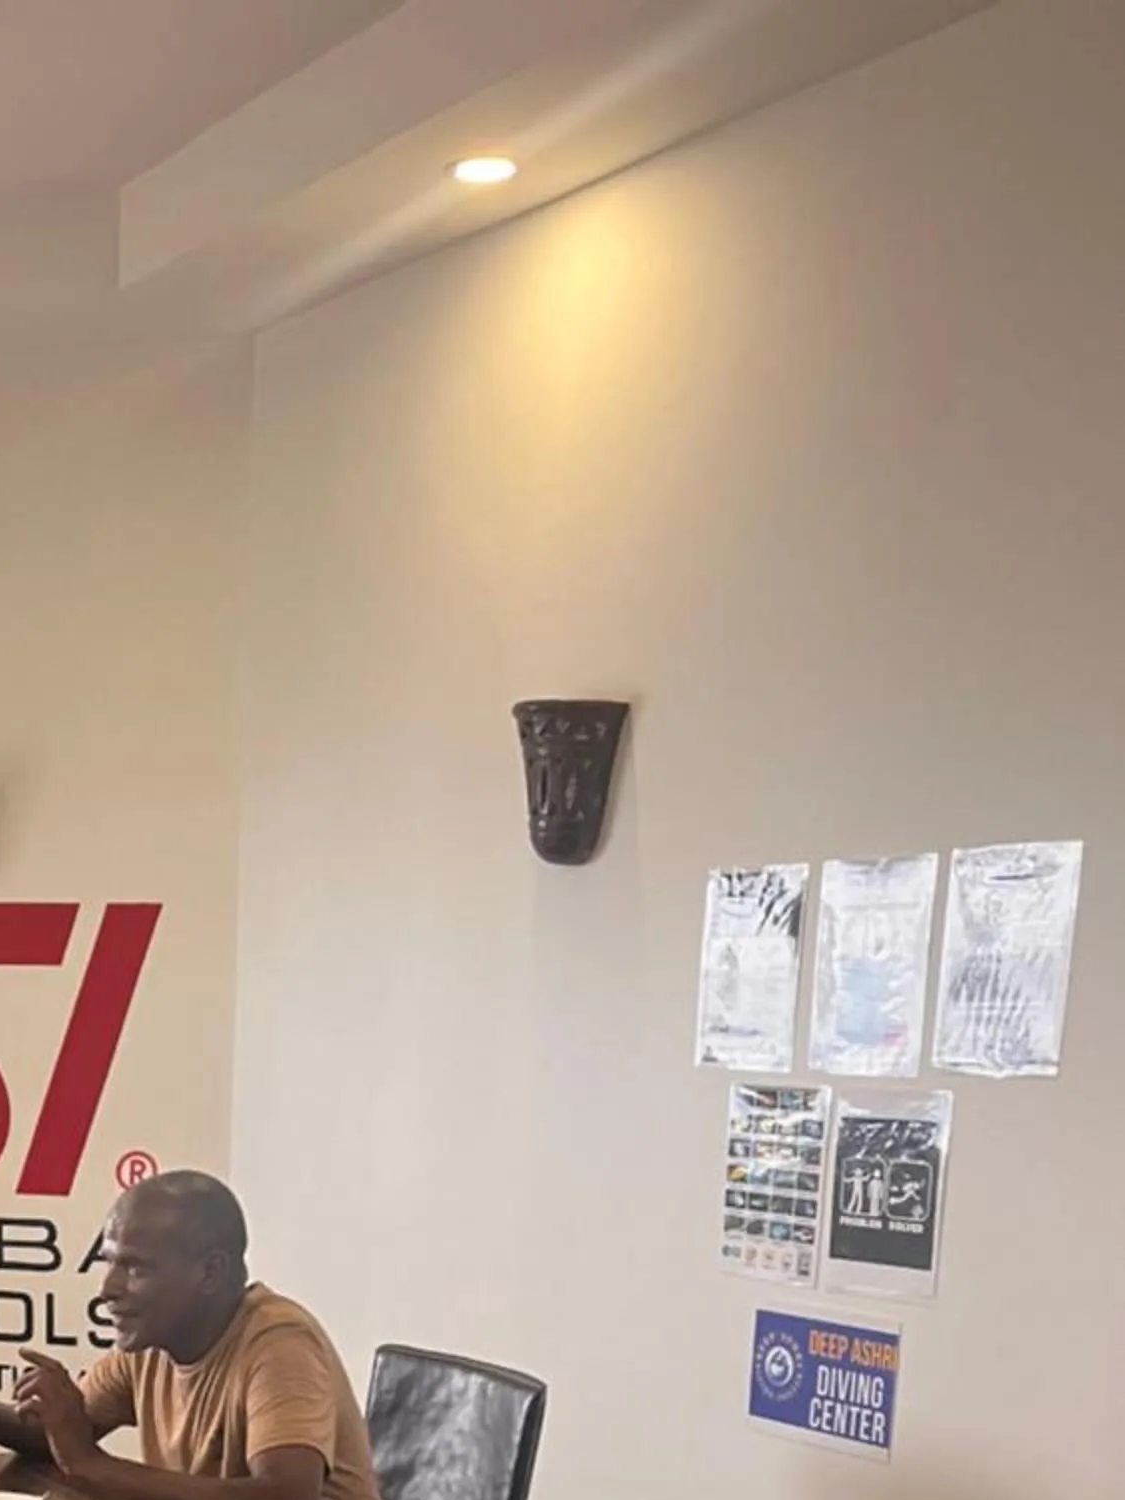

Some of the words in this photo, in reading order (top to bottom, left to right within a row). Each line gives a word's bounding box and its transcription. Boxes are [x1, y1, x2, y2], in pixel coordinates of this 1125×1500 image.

[808, 1329, 849, 1361] DEEP
[816, 1364, 885, 1409] DIVING
[808, 1397, 887, 1444] CENTER
